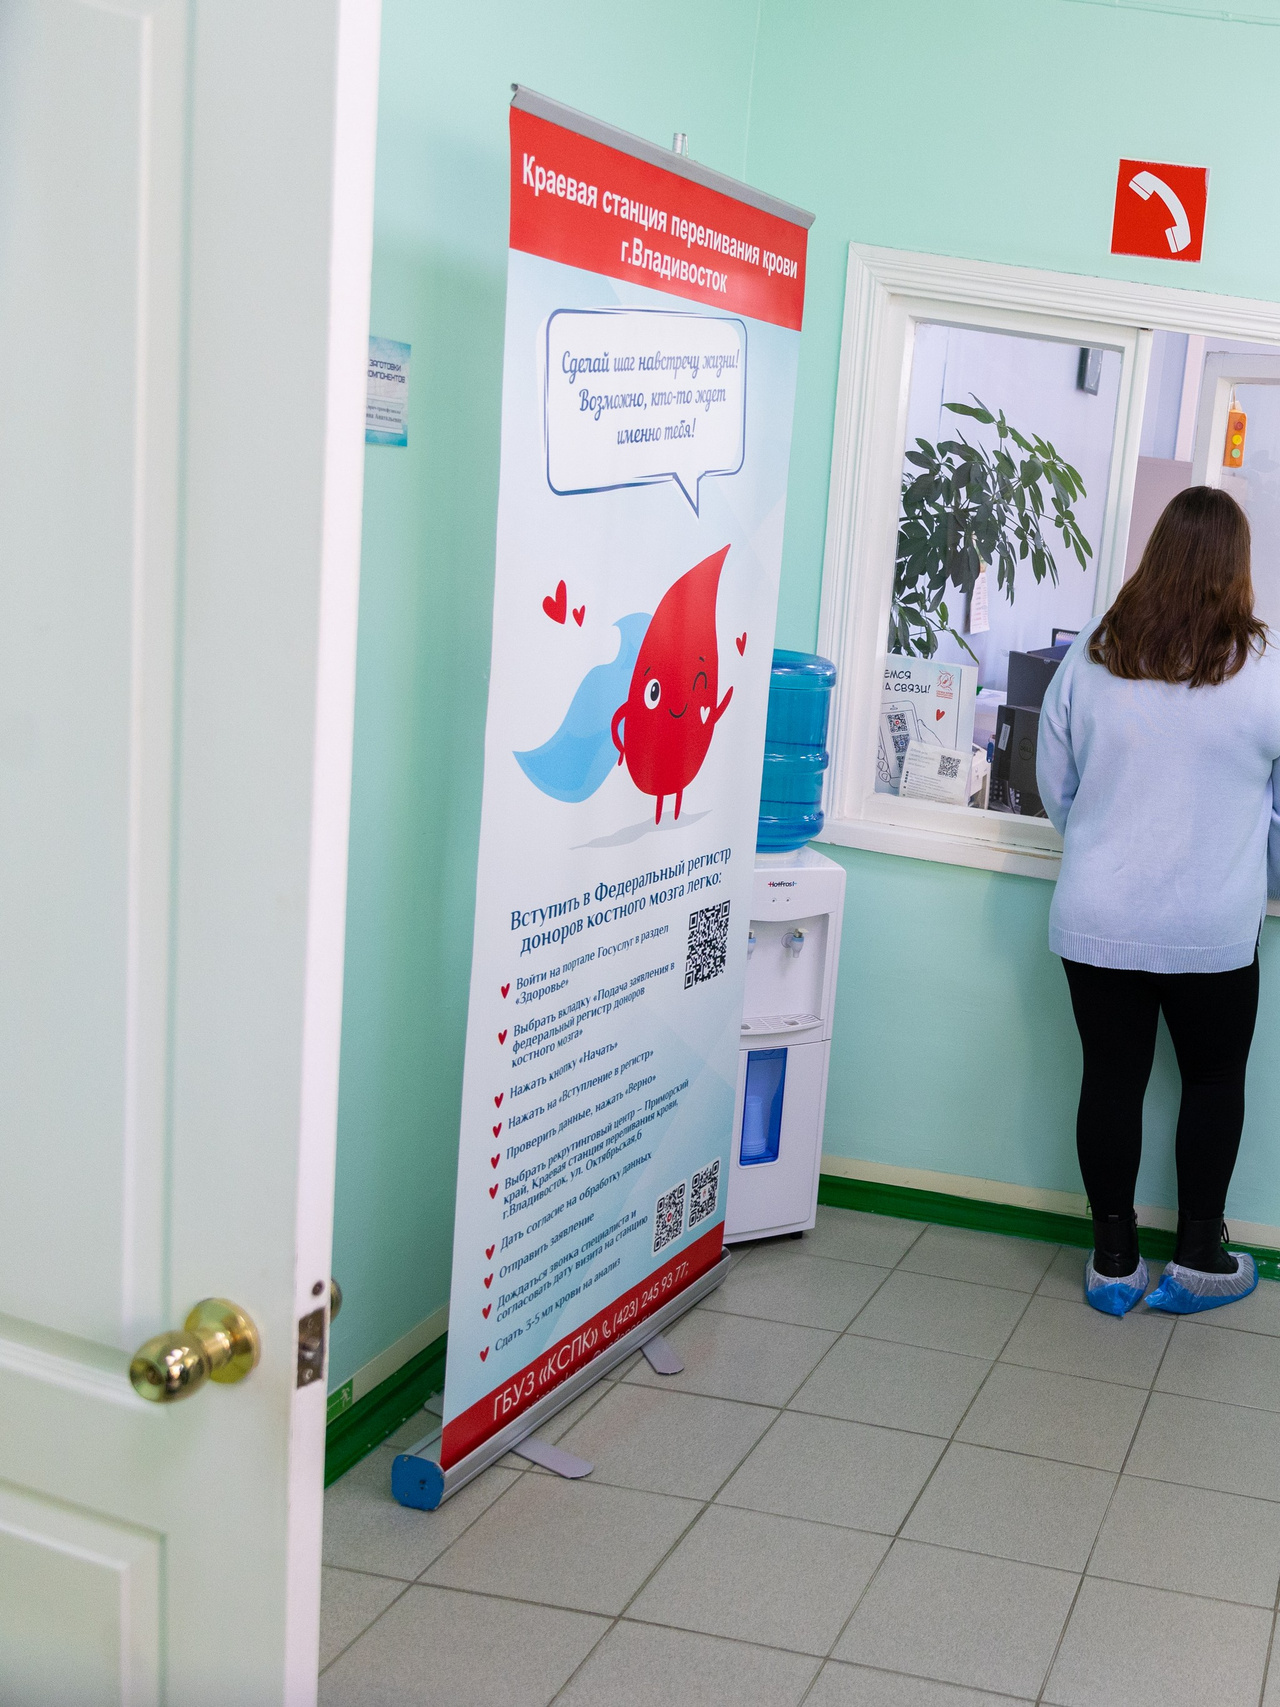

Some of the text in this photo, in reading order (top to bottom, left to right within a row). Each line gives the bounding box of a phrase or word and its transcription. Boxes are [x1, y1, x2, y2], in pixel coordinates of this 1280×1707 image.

[522, 153, 798, 279] Краевая станция переливания крови
[620, 237, 728, 293] г.Владивосток
[561, 349, 740, 384] Сделай шаг навстречу жизни!
[578, 387, 726, 421] Возможно, кто-то ждет
[617, 418, 696, 445] именно тебя!
[894, 683, 931, 694] СВЯЗИ!
[510, 847, 731, 931] Вступить в Федеральный регистр
[519, 871, 722, 957] доноров костного мозга легко:
[515, 979, 569, 1005] «Здоровье»
[516, 924, 669, 990] Войти на портале Госуслуг в раздел
[512, 986, 645, 1054] федеральный регистр доноров
[514, 961, 675, 1037] Выбрать вкладку «Подача заявления в
[510, 1042, 618, 1098] Нажать кнопку «Начать»
[511, 1030, 583, 1068] костного мозга»
[506, 1076, 657, 1160] Проверить данные, нажать «Верно»
[508, 1051, 654, 1129] Нажать на «Вступление в регистр»
[503, 1188, 529, 1205] край,
[532, 1164, 566, 1188] Краевая
[568, 1144, 603, 1168] станция
[605, 1112, 655, 1148] переливания
[504, 1163, 546, 1190] Выбрать
[547, 1122, 613, 1169] рекрутинговый
[614, 1111, 635, 1132] центр
[644, 1079, 689, 1110] Приморский
[501, 1152, 652, 1250] Дать согласие на обработку данных
[502, 1178, 568, 1219] г.Владивосток,
[570, 1168, 584, 1183] ул.
[496, 1215, 649, 1322] согласовать дату визита на станцию
[497, 1209, 637, 1308] Дождаться звонка специалиста и
[499, 1212, 595, 1278] Отправить заявление
[495, 1257, 621, 1351] Сдать 3-5 мл крови на анализ
[493, 1368, 534, 1421] ГБУЗ
[538, 1327, 598, 1385] «КСПК»
[613, 1297, 639, 1333] (423)
[641, 1282, 660, 1309] 245
[660, 1272, 673, 1292] 93
